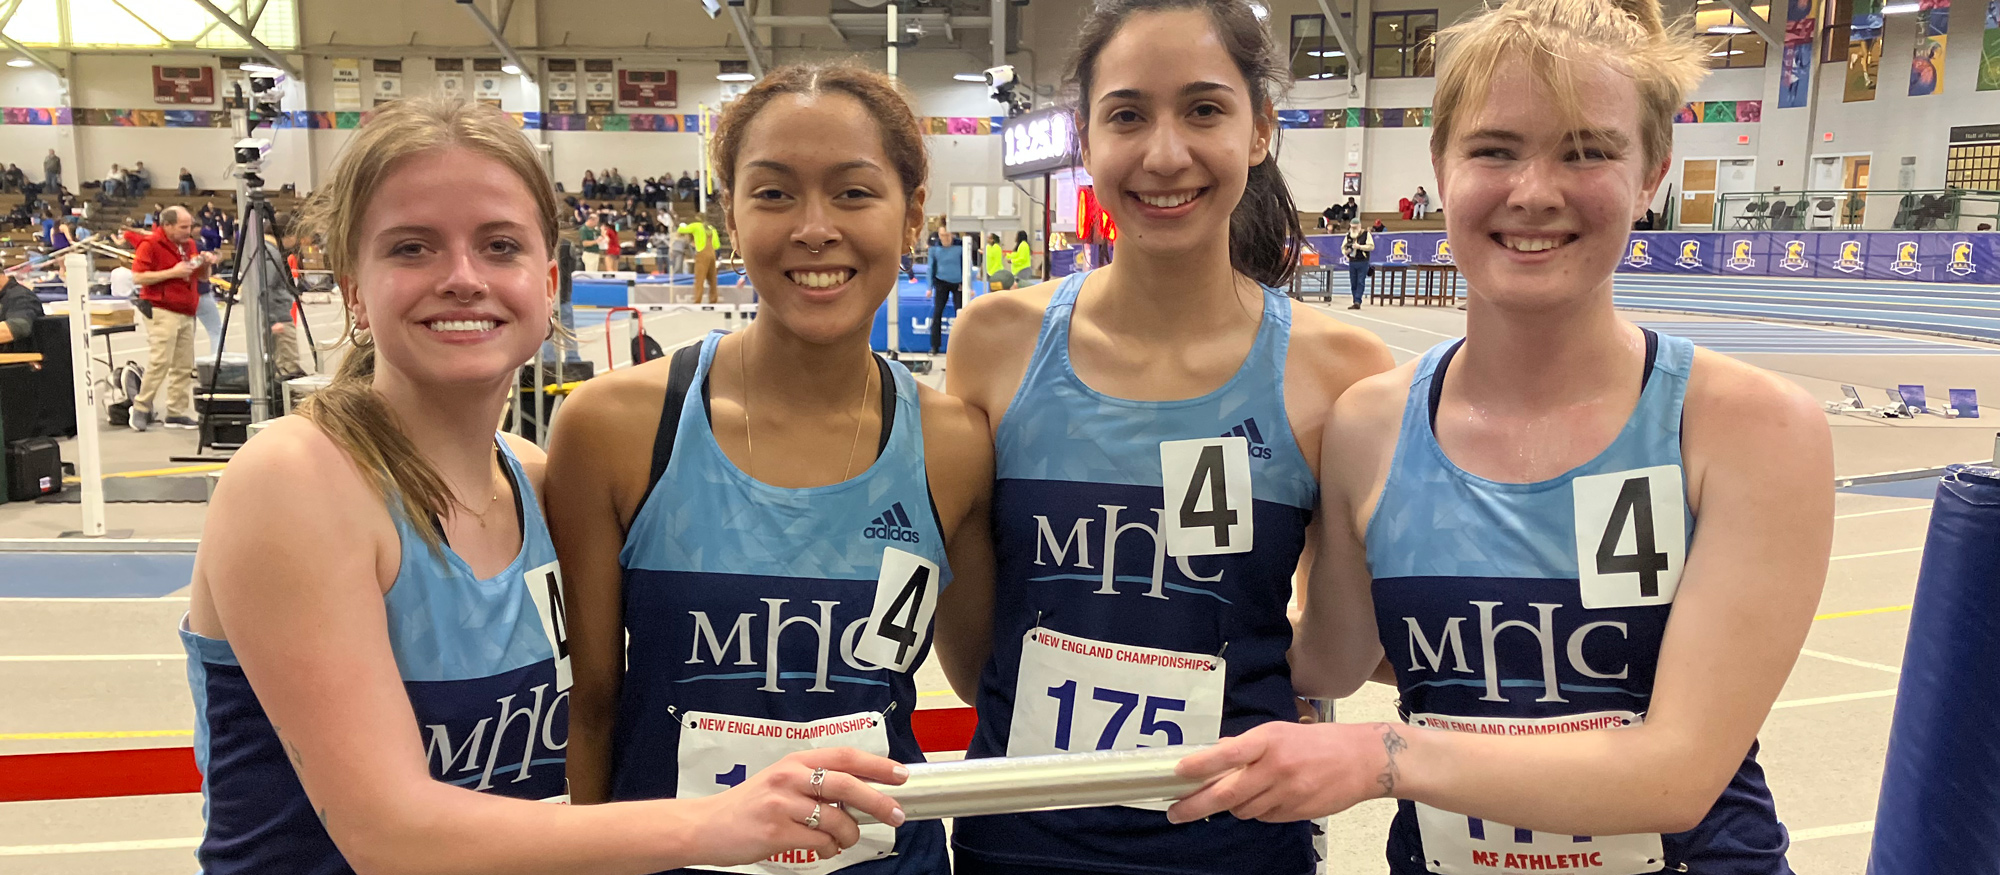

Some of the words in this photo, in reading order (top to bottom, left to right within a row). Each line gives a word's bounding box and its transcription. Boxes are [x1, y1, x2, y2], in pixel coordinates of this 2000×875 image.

[80, 294, 94, 406] FINISH
[1179, 444, 1238, 548] 4
[863, 524, 920, 543] adidas
[1595, 476, 1669, 598] 4
[877, 564, 930, 666] 4
[1038, 632, 1060, 648] NEW
[1061, 639, 1113, 660] ENGLAND
[1116, 649, 1211, 671] CHAMPIONSHIPS
[1402, 600, 1629, 703] MHC
[699, 718, 725, 732] NEW
[727, 720, 783, 738] ENGLAND
[785, 717, 874, 739] CHAMPIONSHIPS
[1047, 679, 1186, 751] 175
[1425, 717, 1450, 730] NEW
[1508, 715, 1622, 736] CHAMPIONSHIPS
[1504, 851, 1603, 870] ATHLETIC
